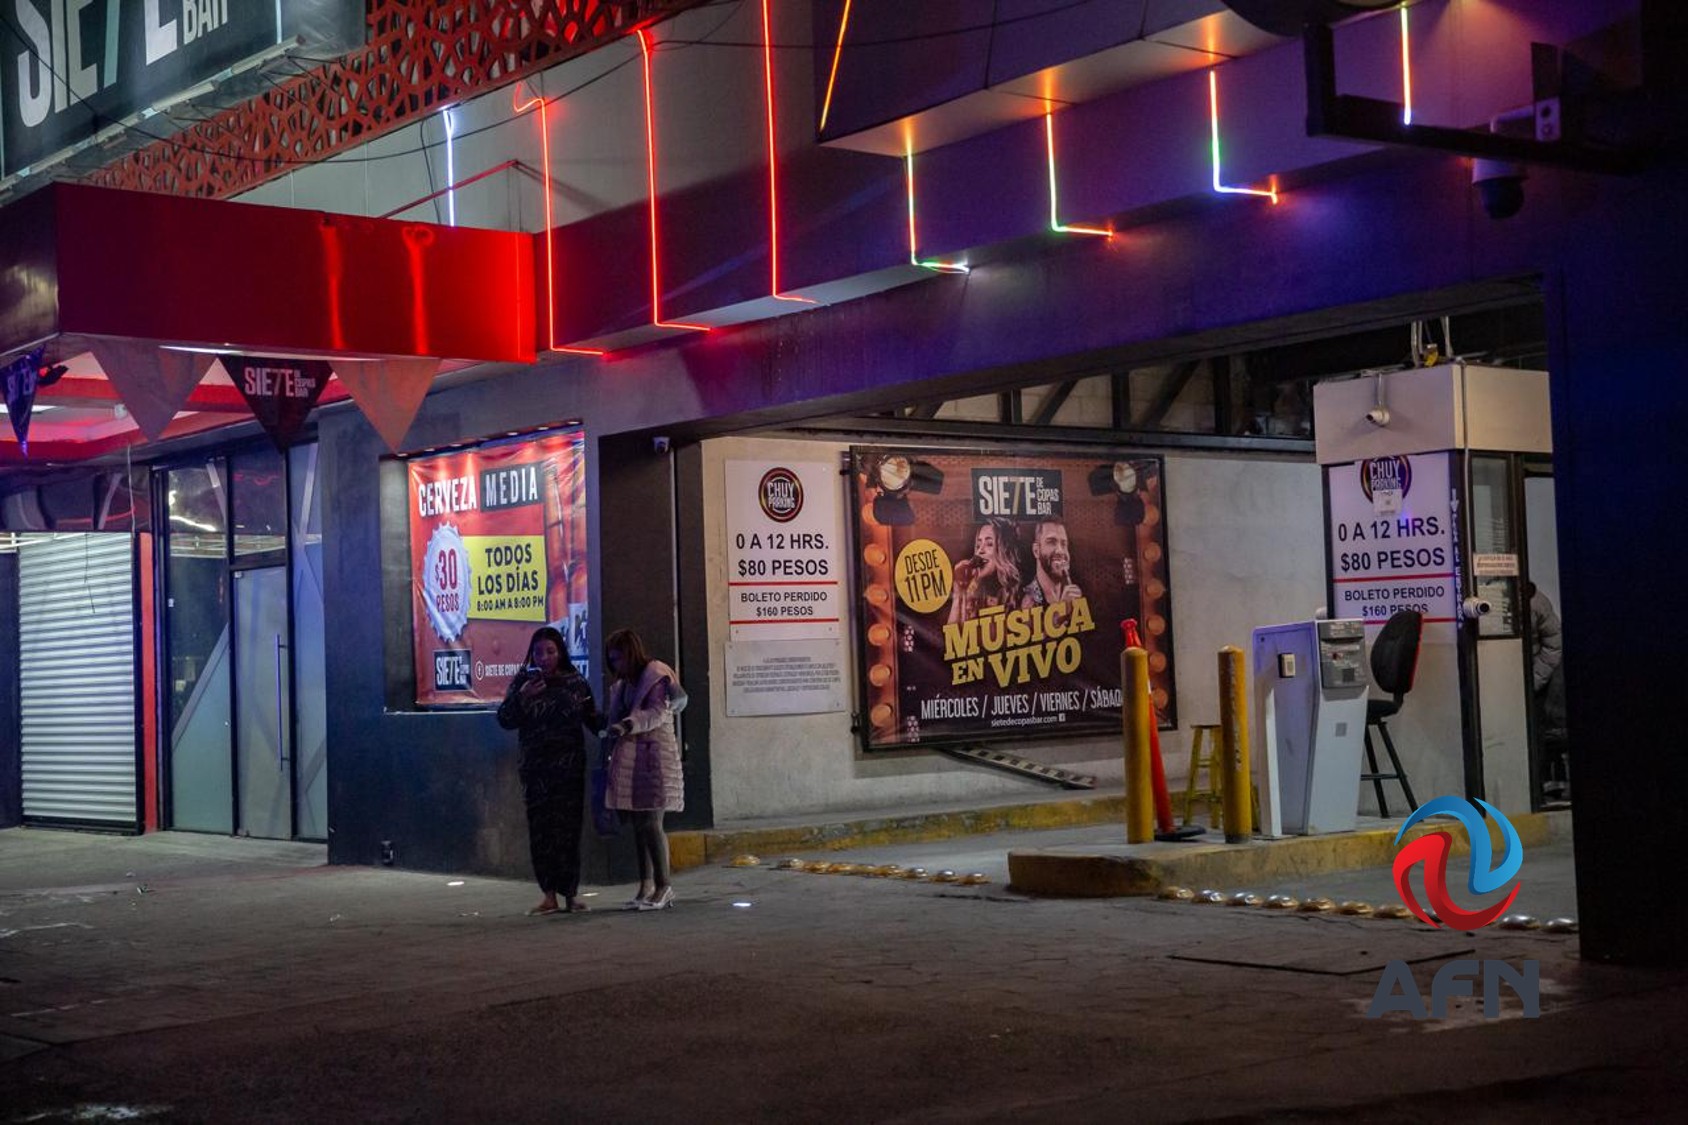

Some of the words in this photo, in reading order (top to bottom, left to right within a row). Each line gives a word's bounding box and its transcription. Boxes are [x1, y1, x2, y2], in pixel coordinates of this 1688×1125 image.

[1370, 460, 1400, 479] CHUY
[767, 481, 795, 497] CHUY
[1036, 477, 1043, 487] DE
[418, 475, 477, 517] CERVEZA
[485, 466, 538, 507] MEDIA
[1036, 488, 1059, 501] COPAS
[1037, 502, 1051, 515] BAR
[1338, 525, 1347, 541] 0
[1353, 522, 1365, 541] A
[1371, 520, 1390, 539] 12
[1397, 516, 1445, 537] HRS.
[736, 534, 745, 549] 0
[750, 534, 762, 549] A
[767, 534, 785, 549] 12
[790, 533, 829, 549] HRS.
[485, 543, 532, 567] TODOS
[904, 549, 940, 575] DESDE
[1340, 552, 1371, 572] $80
[1378, 548, 1445, 570] PESOS
[434, 548, 458, 590] $30
[738, 560, 766, 577] $80
[772, 559, 829, 575] PESOS
[477, 574, 502, 595] LOS
[506, 566, 539, 593] DÍAS
[436, 593, 459, 612] PESOS
[741, 592, 782, 602] BOLETO
[784, 592, 827, 602] PERDIDO
[1345, 589, 1390, 601] BOLETO
[1393, 586, 1445, 599] PERDIDO
[477, 600, 492, 611] 8:00
[495, 600, 506, 611] AM
[508, 599, 513, 609] A
[514, 597, 531, 609] 8:00
[533, 596, 544, 607] PM
[756, 606, 778, 617] $160
[781, 606, 813, 616] PESOS
[1362, 605, 1387, 616] $160
[1390, 603, 1428, 615] PESOS
[943, 597, 1095, 661] MÚSICA
[952, 657, 984, 686] EN
[988, 637, 1082, 688] VIVO
[921, 694, 979, 720] MIÉRCOLES
[982, 695, 989, 717] /
[991, 694, 1029, 716] JUEVES
[1031, 692, 1038, 714] /
[1039, 691, 1080, 712] VIERNES
[1082, 689, 1088, 711] /
[1090, 686, 1123, 709] SÁBAD
[991, 715, 1058, 728] sietedecopasbar.com
